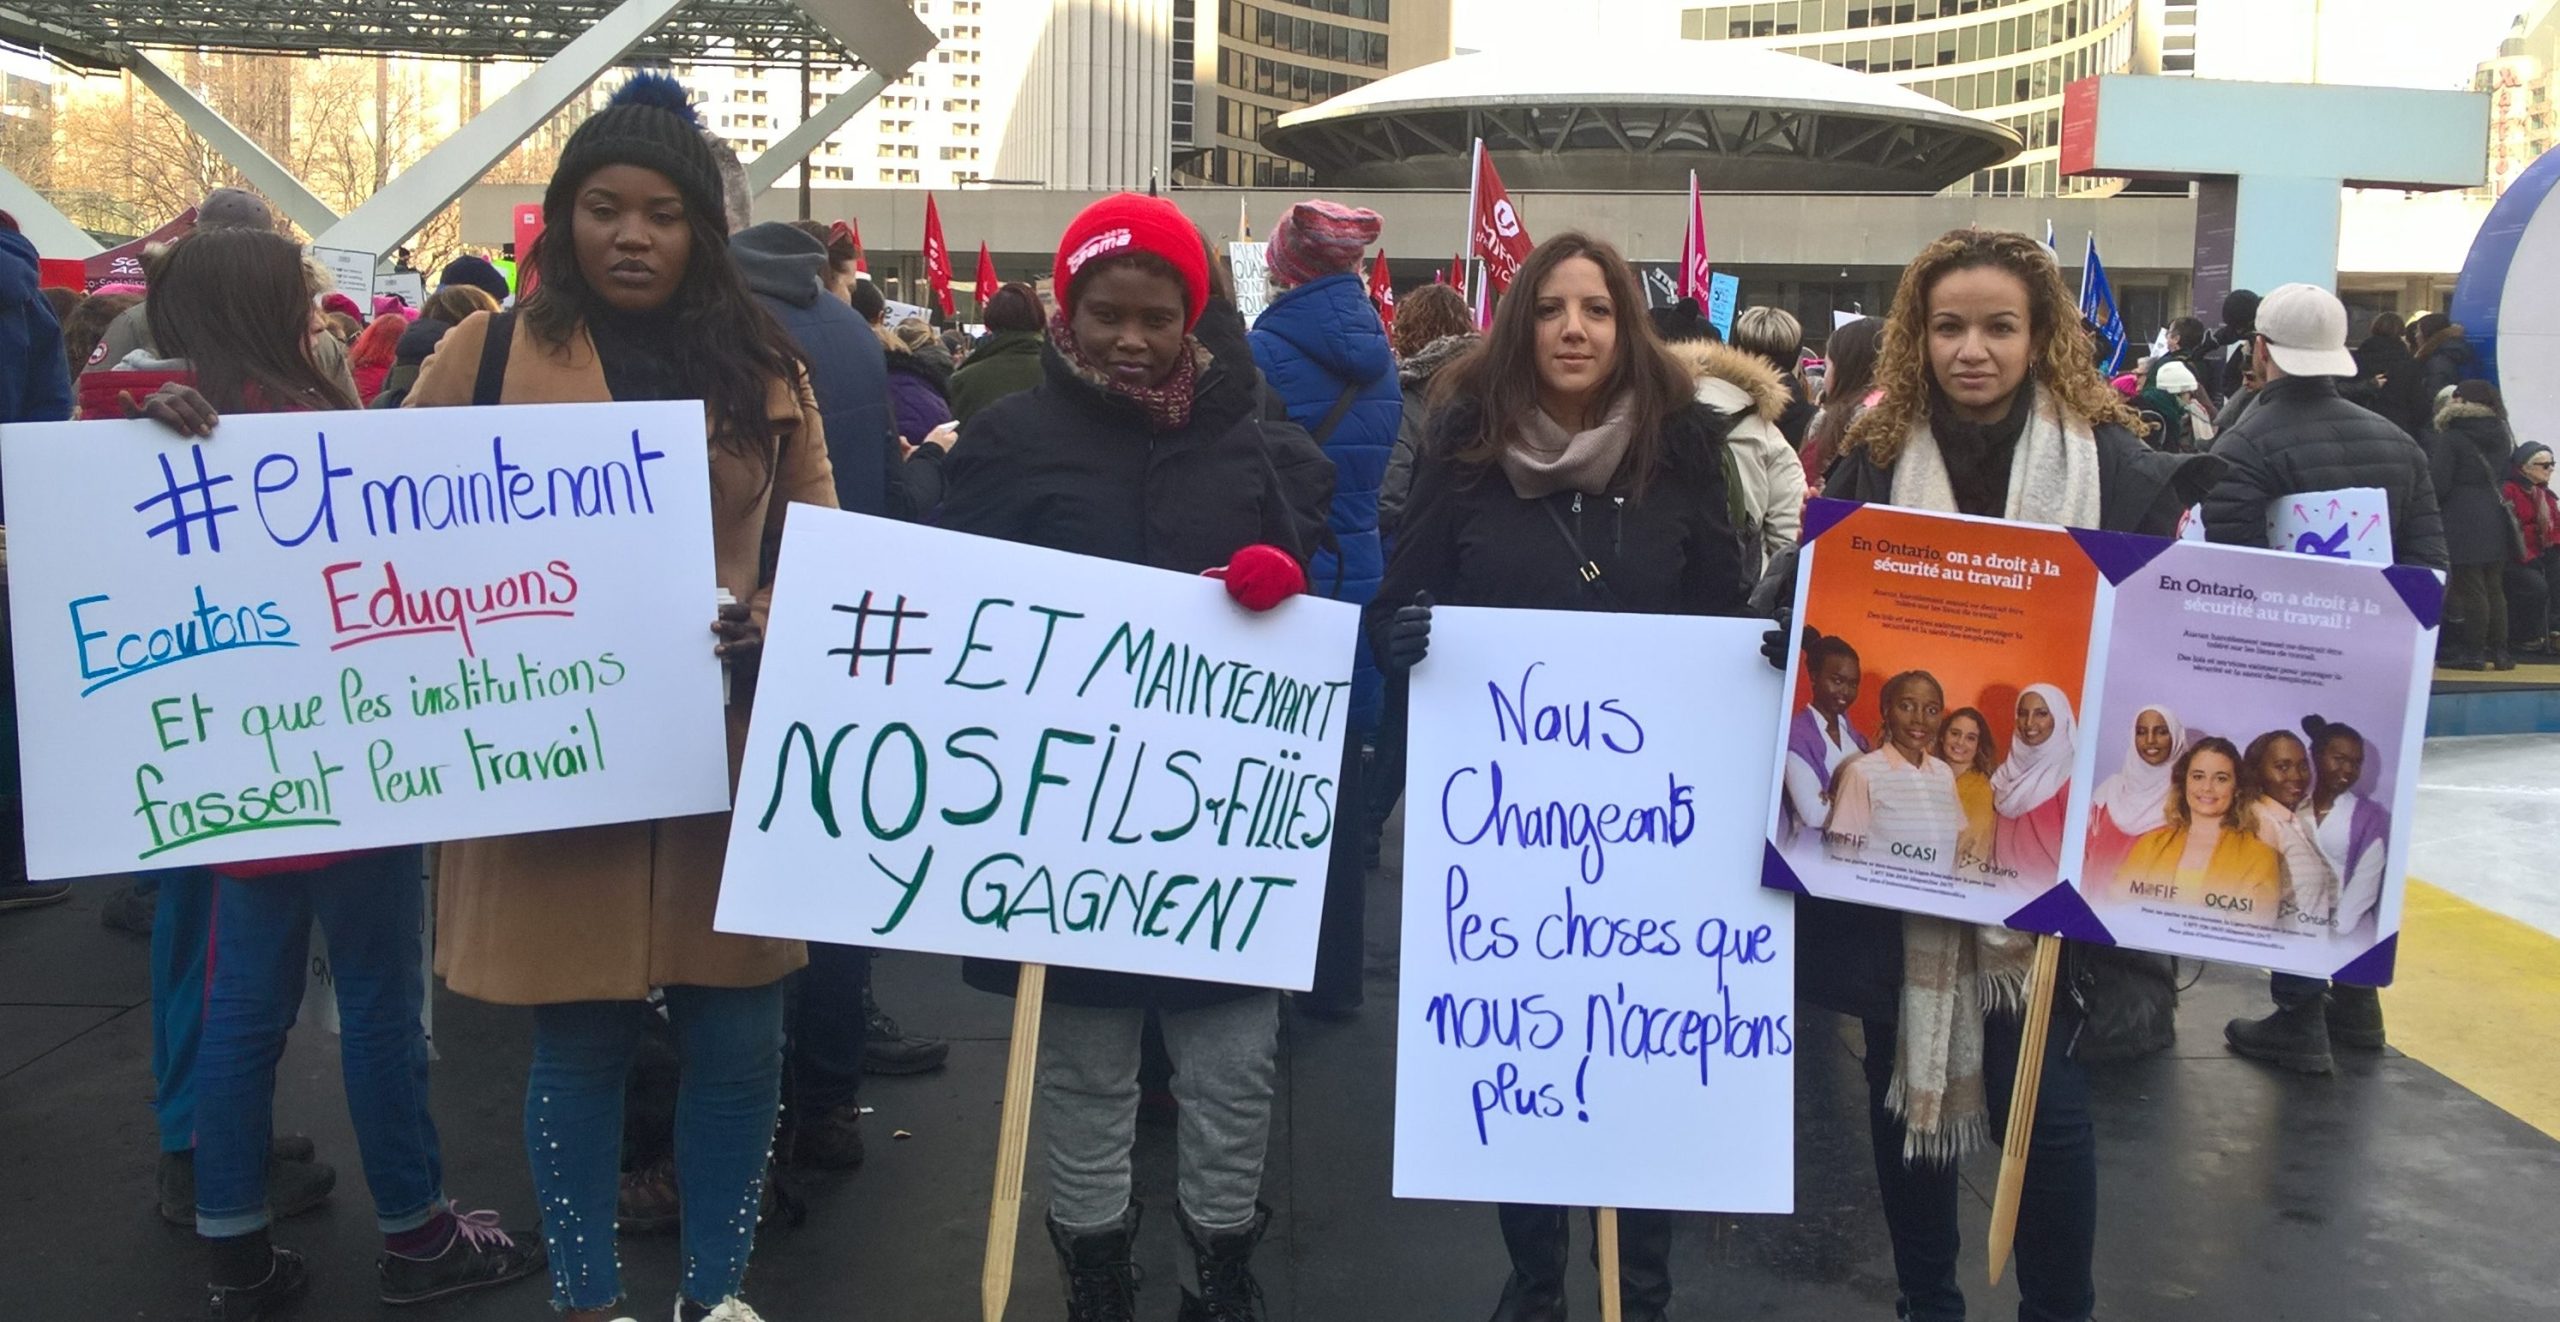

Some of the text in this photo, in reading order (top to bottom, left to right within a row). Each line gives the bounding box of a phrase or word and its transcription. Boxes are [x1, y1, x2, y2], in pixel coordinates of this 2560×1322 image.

[1851, 536, 2061, 577] En Ontario, on a droit à la
[1873, 557, 1940, 579] sécurité
[1941, 568, 1964, 582] au
[2159, 575, 2380, 615] En Ontario, on a droit à la
[69, 561, 577, 679] Ecoutons Eduquons
[2184, 597, 2254, 618] sécurité
[2256, 608, 2279, 621] au
[152, 651, 625, 774] Et que les institutions
[1078, 622, 1351, 740] MAINTENANT
[1488, 661, 1644, 754] Nous
[135, 708, 605, 848] fassent leur travail
[759, 721, 1002, 840] NOS
[961, 853, 1296, 952] GAGNENT
[1890, 841, 1937, 862] OCASI
[1978, 862, 2019, 880] Ontario
[1446, 864, 1776, 990] les choses que
[2205, 893, 2253, 913] OCASI
[2297, 911, 2340, 929] Ontario
[1426, 982, 1793, 1086] nous n'acceptons
